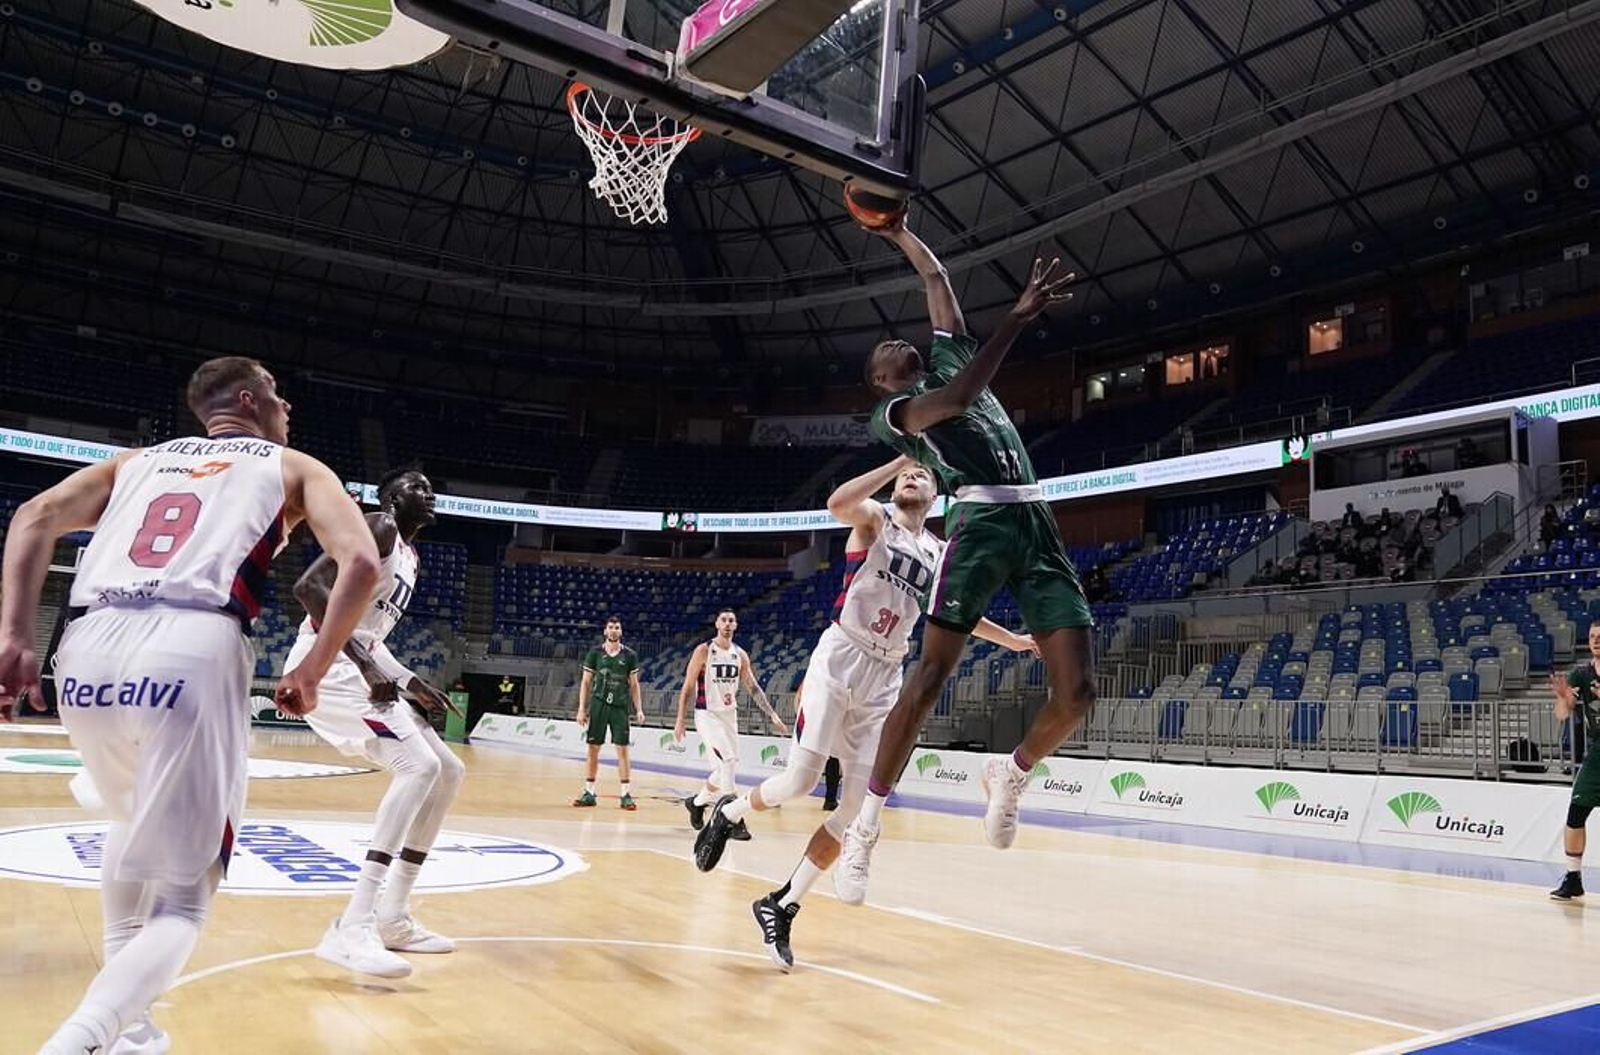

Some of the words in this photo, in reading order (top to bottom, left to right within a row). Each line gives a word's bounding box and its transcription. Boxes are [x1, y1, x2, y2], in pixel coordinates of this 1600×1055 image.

[11, 436, 33, 448] TODO
[35, 439, 46, 450] LO
[47, 441, 64, 453] QUE
[67, 444, 77, 454] TE
[78, 446, 109, 459] OFRECE
[128, 492, 203, 568] 8
[887, 544, 934, 593] TD
[871, 607, 900, 639] 31
[711, 664, 738, 678] TD
[61, 676, 185, 709] Recalvi
[607, 692, 613, 704] 8
[935, 768, 968, 783] Unicaja
[1043, 778, 1083, 795] Unicaja
[1138, 790, 1184, 808] Unicaja
[1293, 803, 1349, 823] Unicaja
[1435, 816, 1504, 837] Unicaja
